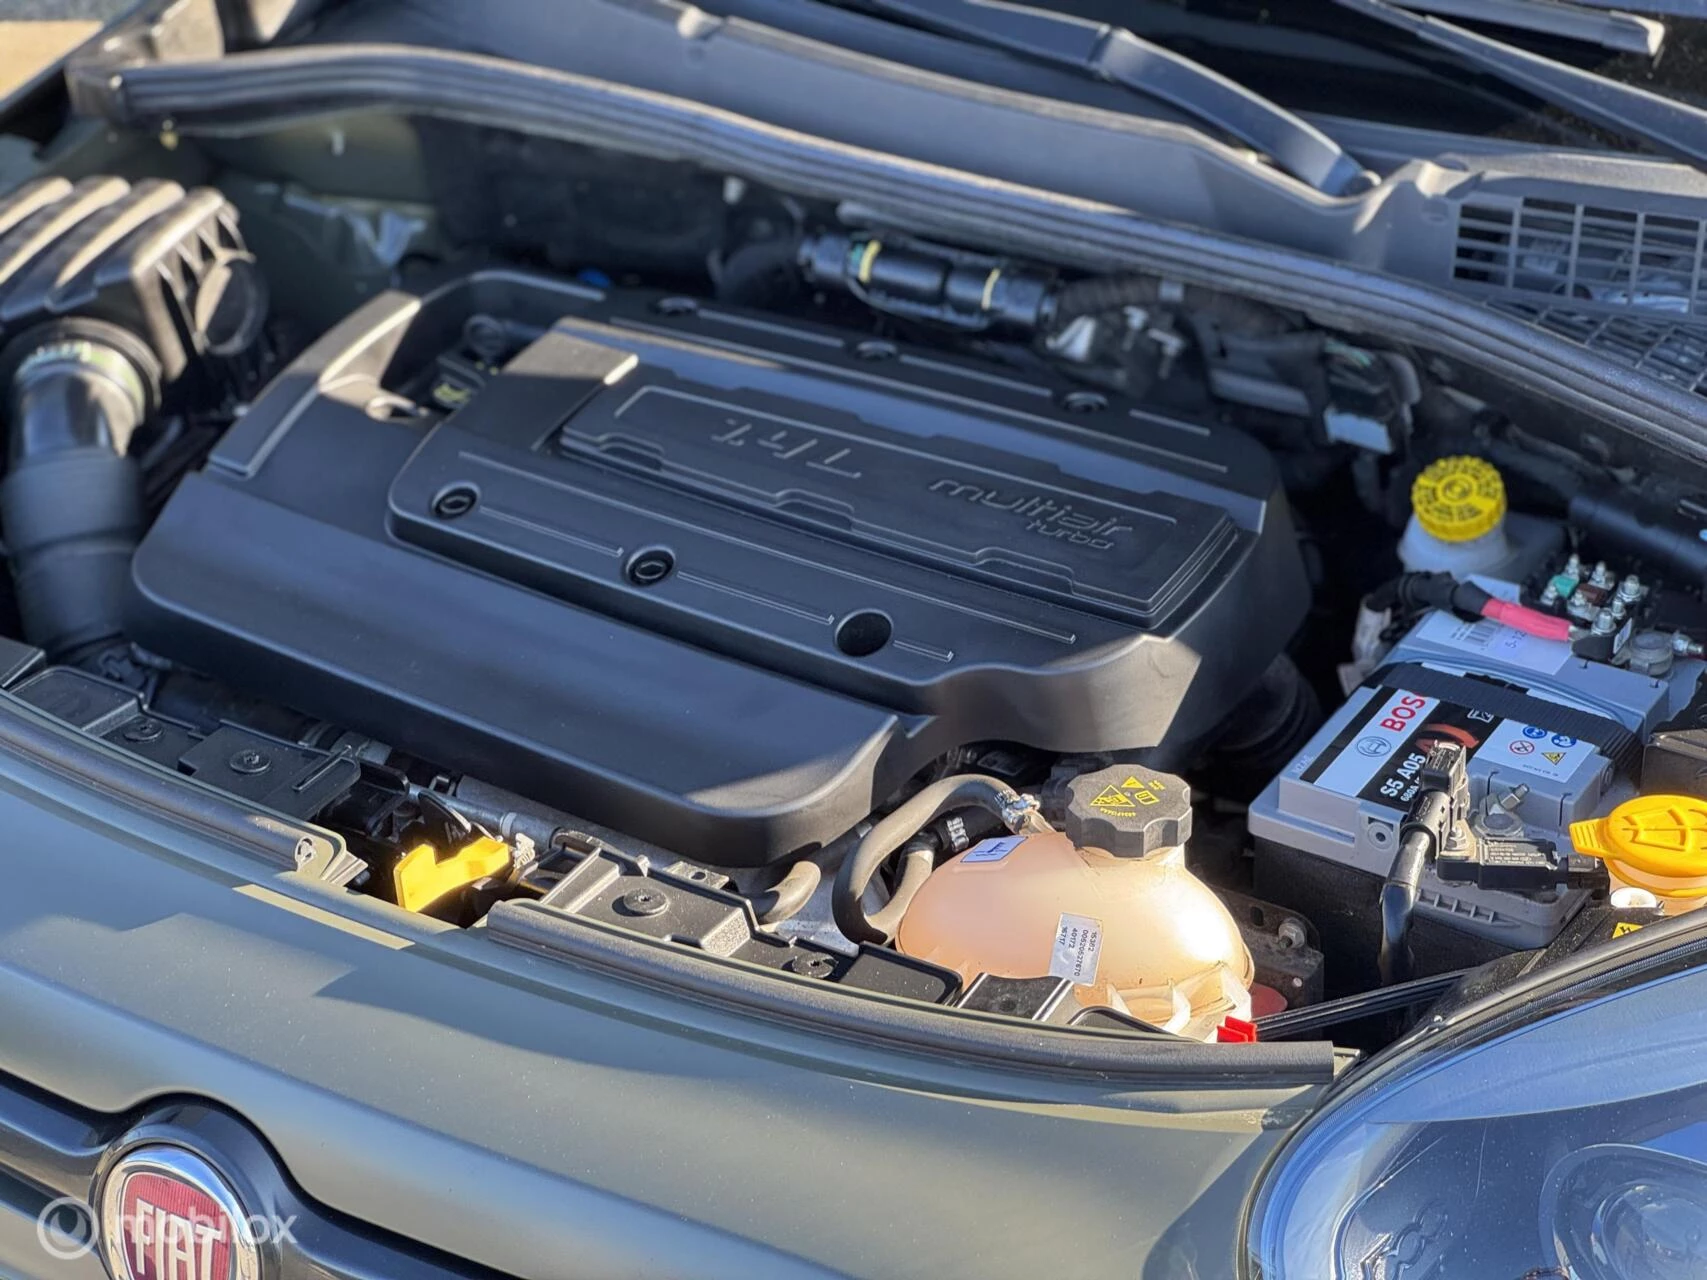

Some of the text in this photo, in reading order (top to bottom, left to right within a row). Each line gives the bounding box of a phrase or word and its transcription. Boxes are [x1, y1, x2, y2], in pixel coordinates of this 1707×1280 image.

[928, 479, 1133, 535] multiair
[1025, 519, 1115, 549] turbo
[1380, 694, 1426, 731] BOS
[1380, 752, 1427, 797] S5 A05
[136, 1197, 223, 1280] FIAT
